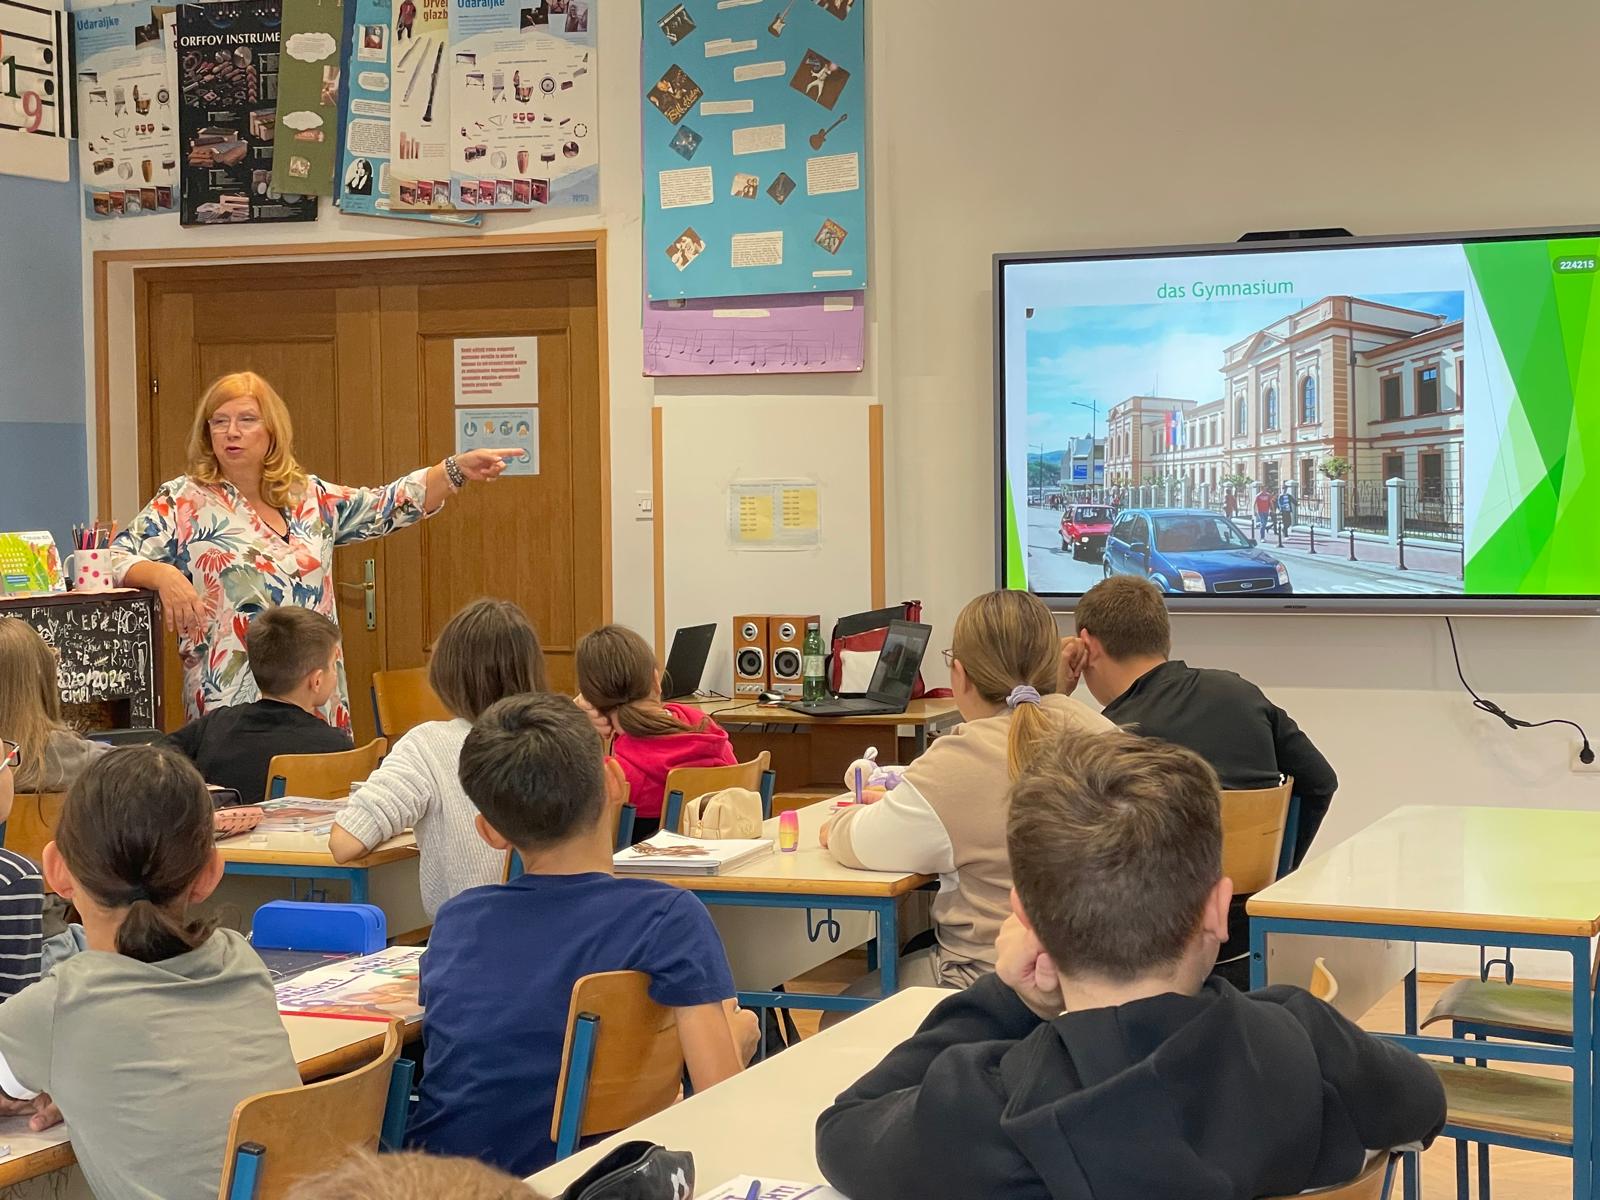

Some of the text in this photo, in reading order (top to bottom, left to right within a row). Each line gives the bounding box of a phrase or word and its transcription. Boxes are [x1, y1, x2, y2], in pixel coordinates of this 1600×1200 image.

[77, 16, 120, 31] Udaraljke
[180, 35, 223, 47] ORFFOV
[226, 32, 280, 45] INSTRUME
[1559, 259, 1596, 270] 224215
[1157, 280, 1294, 301] das Gymnasium
